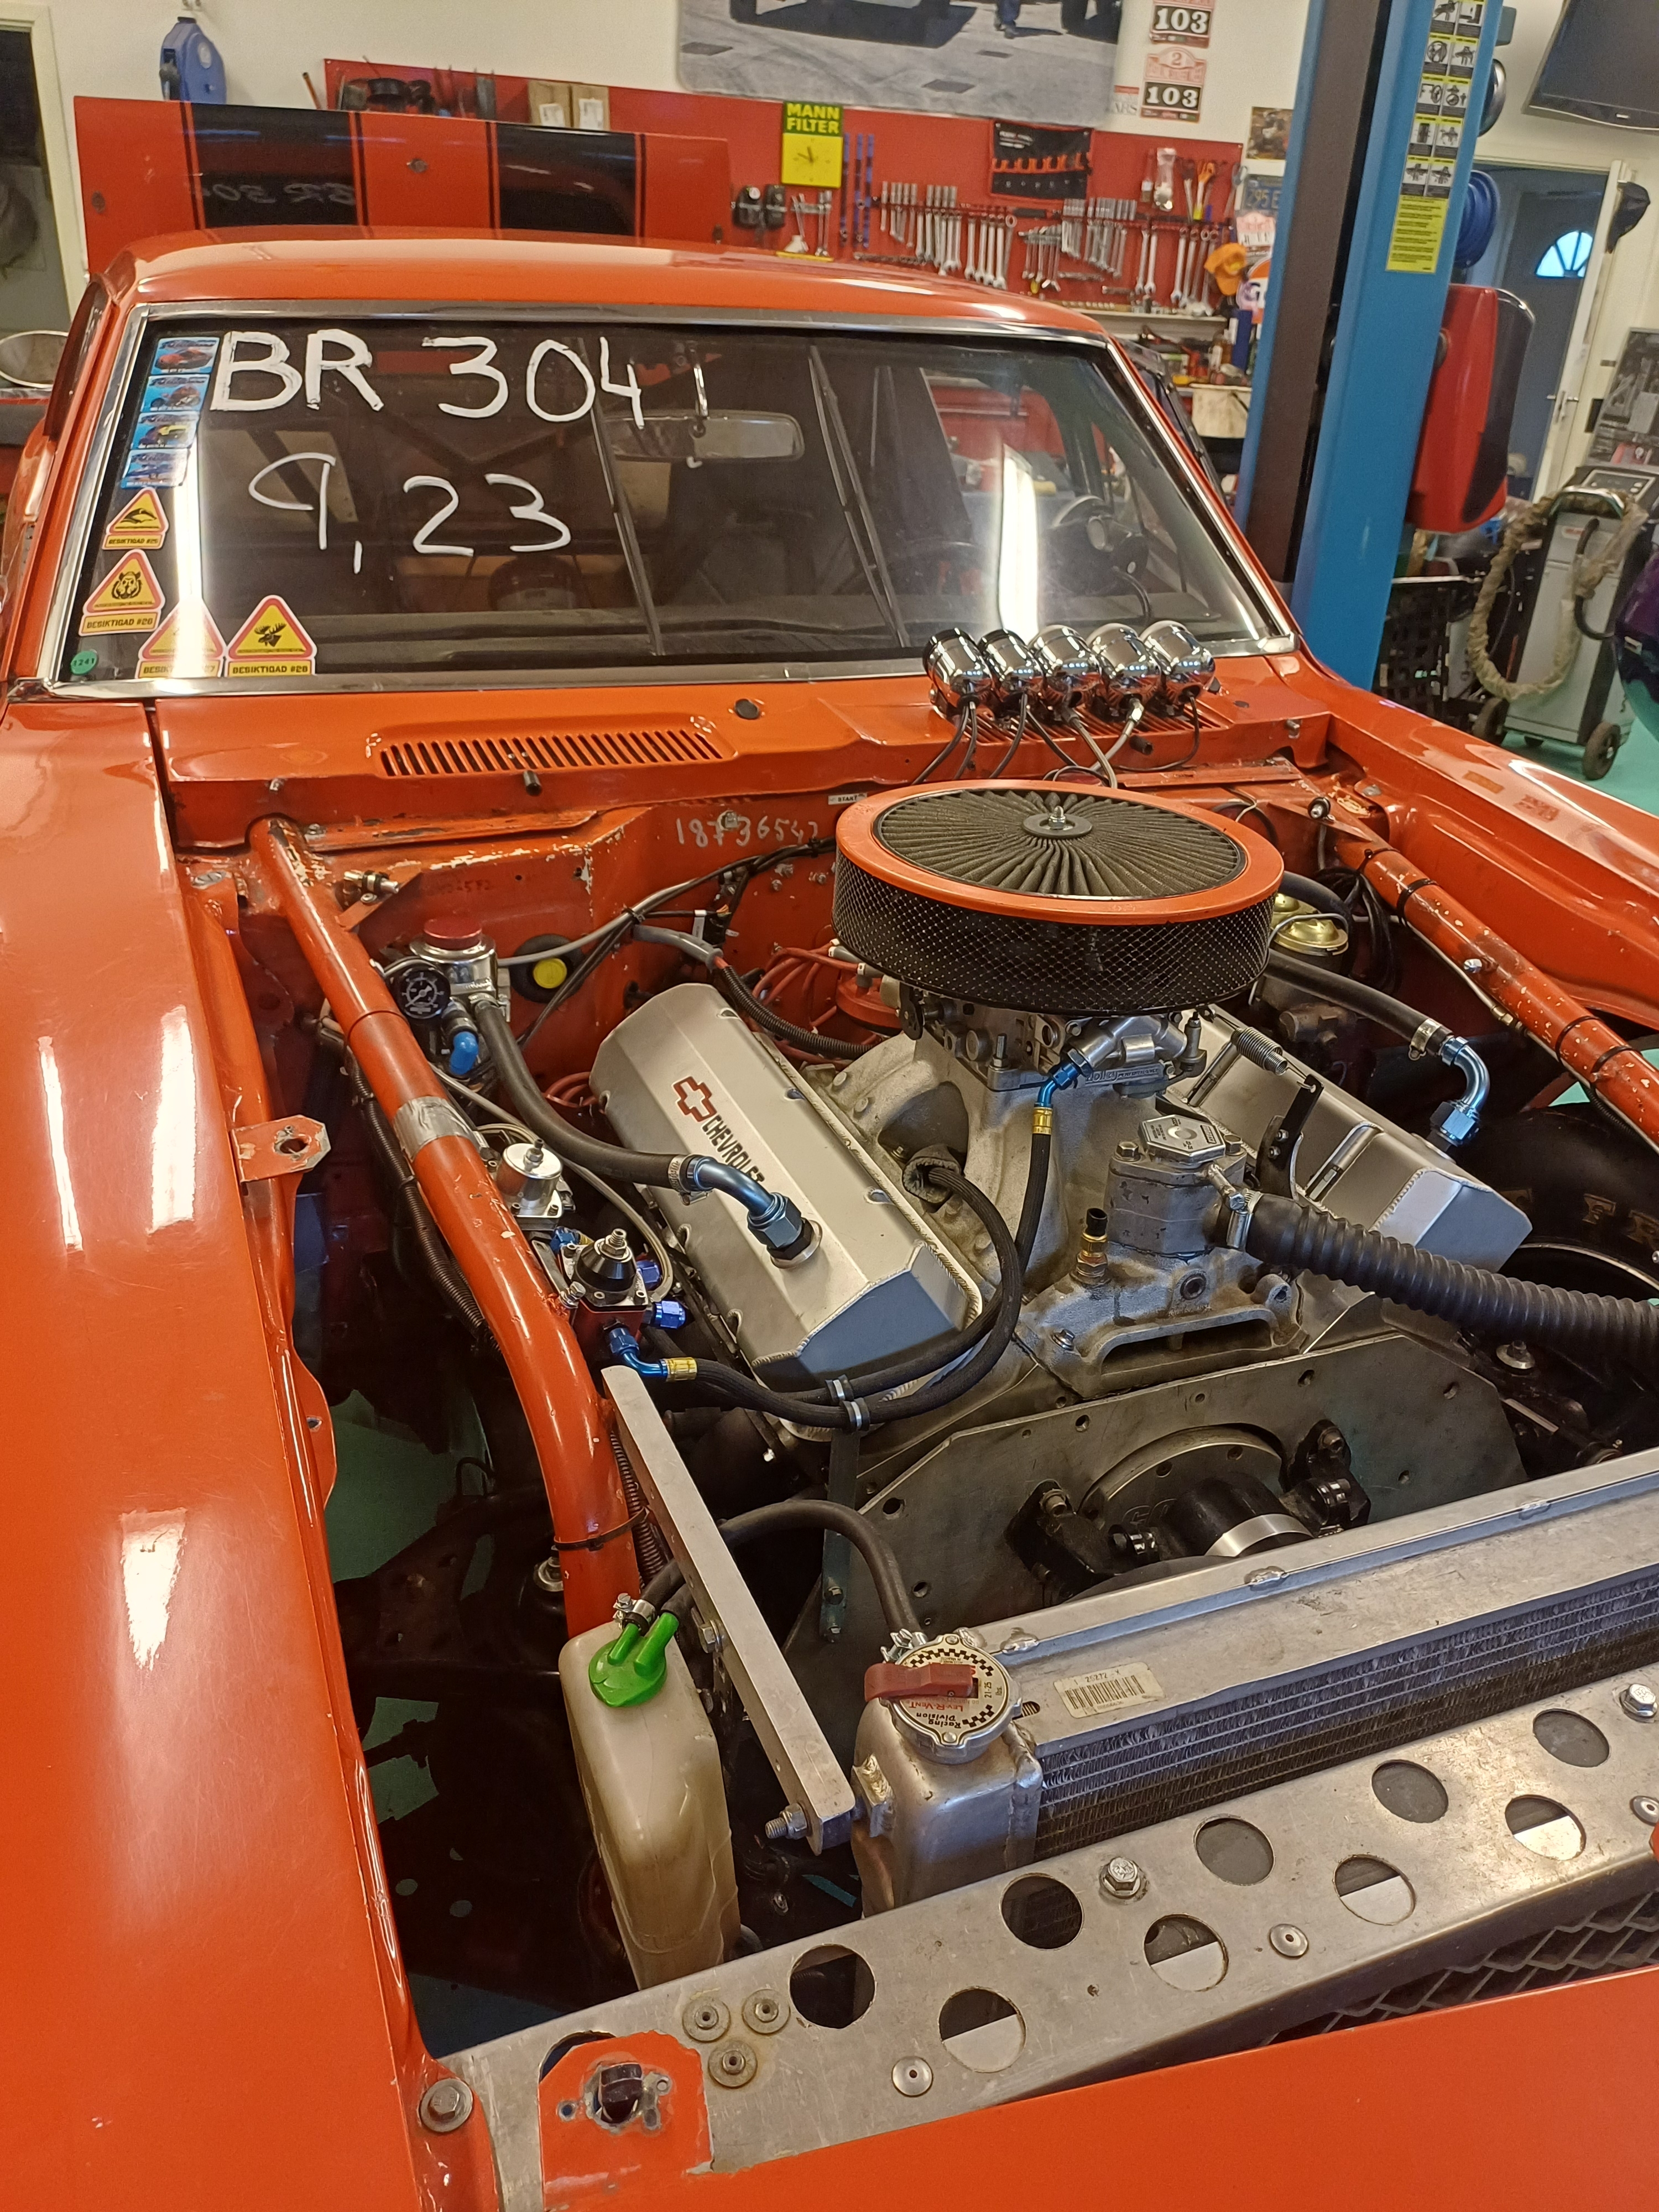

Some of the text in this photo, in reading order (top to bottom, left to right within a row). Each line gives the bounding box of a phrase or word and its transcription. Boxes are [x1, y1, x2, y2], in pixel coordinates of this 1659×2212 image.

[1155, 8, 1208, 34] 103
[1171, 52, 1182, 65] 2
[1146, 86, 1198, 108] 103
[786, 103, 839, 119] MANN
[786, 117, 839, 134] FILTER
[210, 329, 644, 430] BR 304
[984, 1682, 992, 1698] 21-25
[916, 1712, 956, 1722] Division
[928, 1718, 962, 1729] Racing
